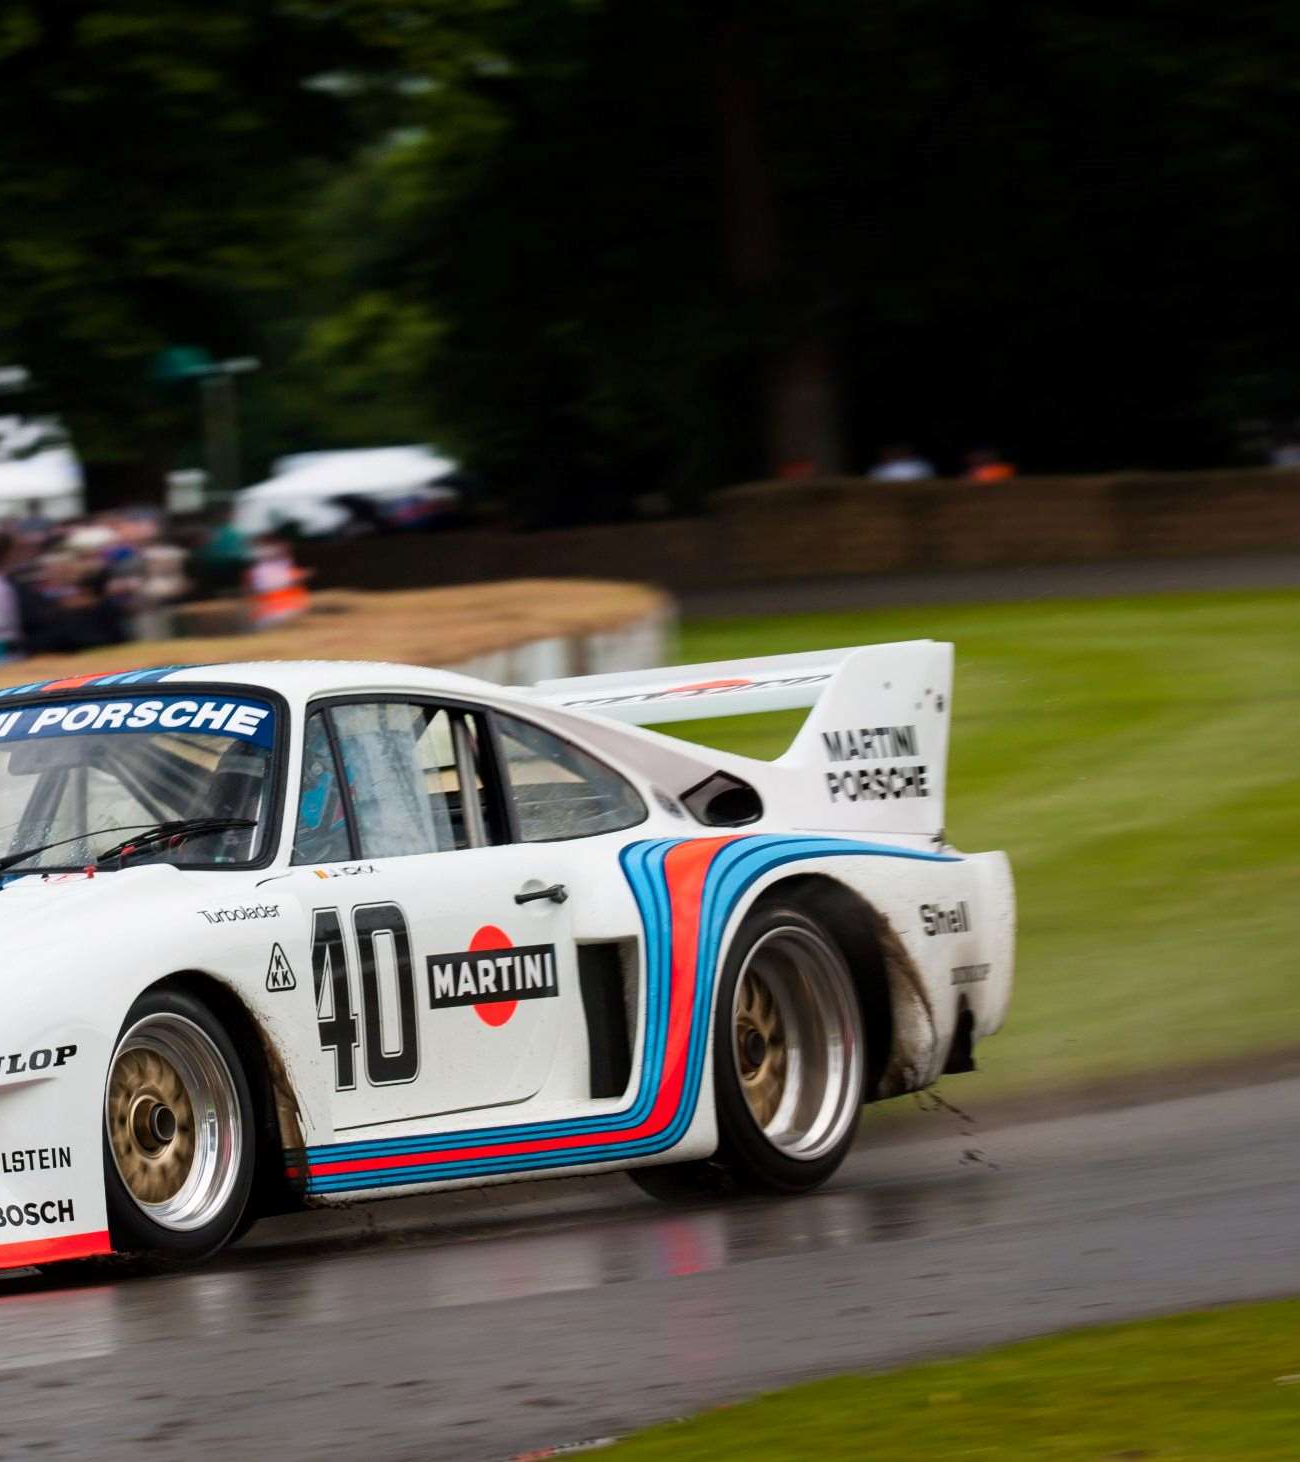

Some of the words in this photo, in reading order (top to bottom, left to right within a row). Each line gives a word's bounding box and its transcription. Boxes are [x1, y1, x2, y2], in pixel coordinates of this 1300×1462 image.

[28, 700, 268, 736] PORSCHE
[821, 725, 918, 761] MARTINI
[826, 765, 930, 803] PORSCHE
[197, 904, 281, 924] Turbolader
[919, 901, 970, 936] Shell
[432, 953, 555, 999] MARTINI
[310, 900, 420, 1092] 40
